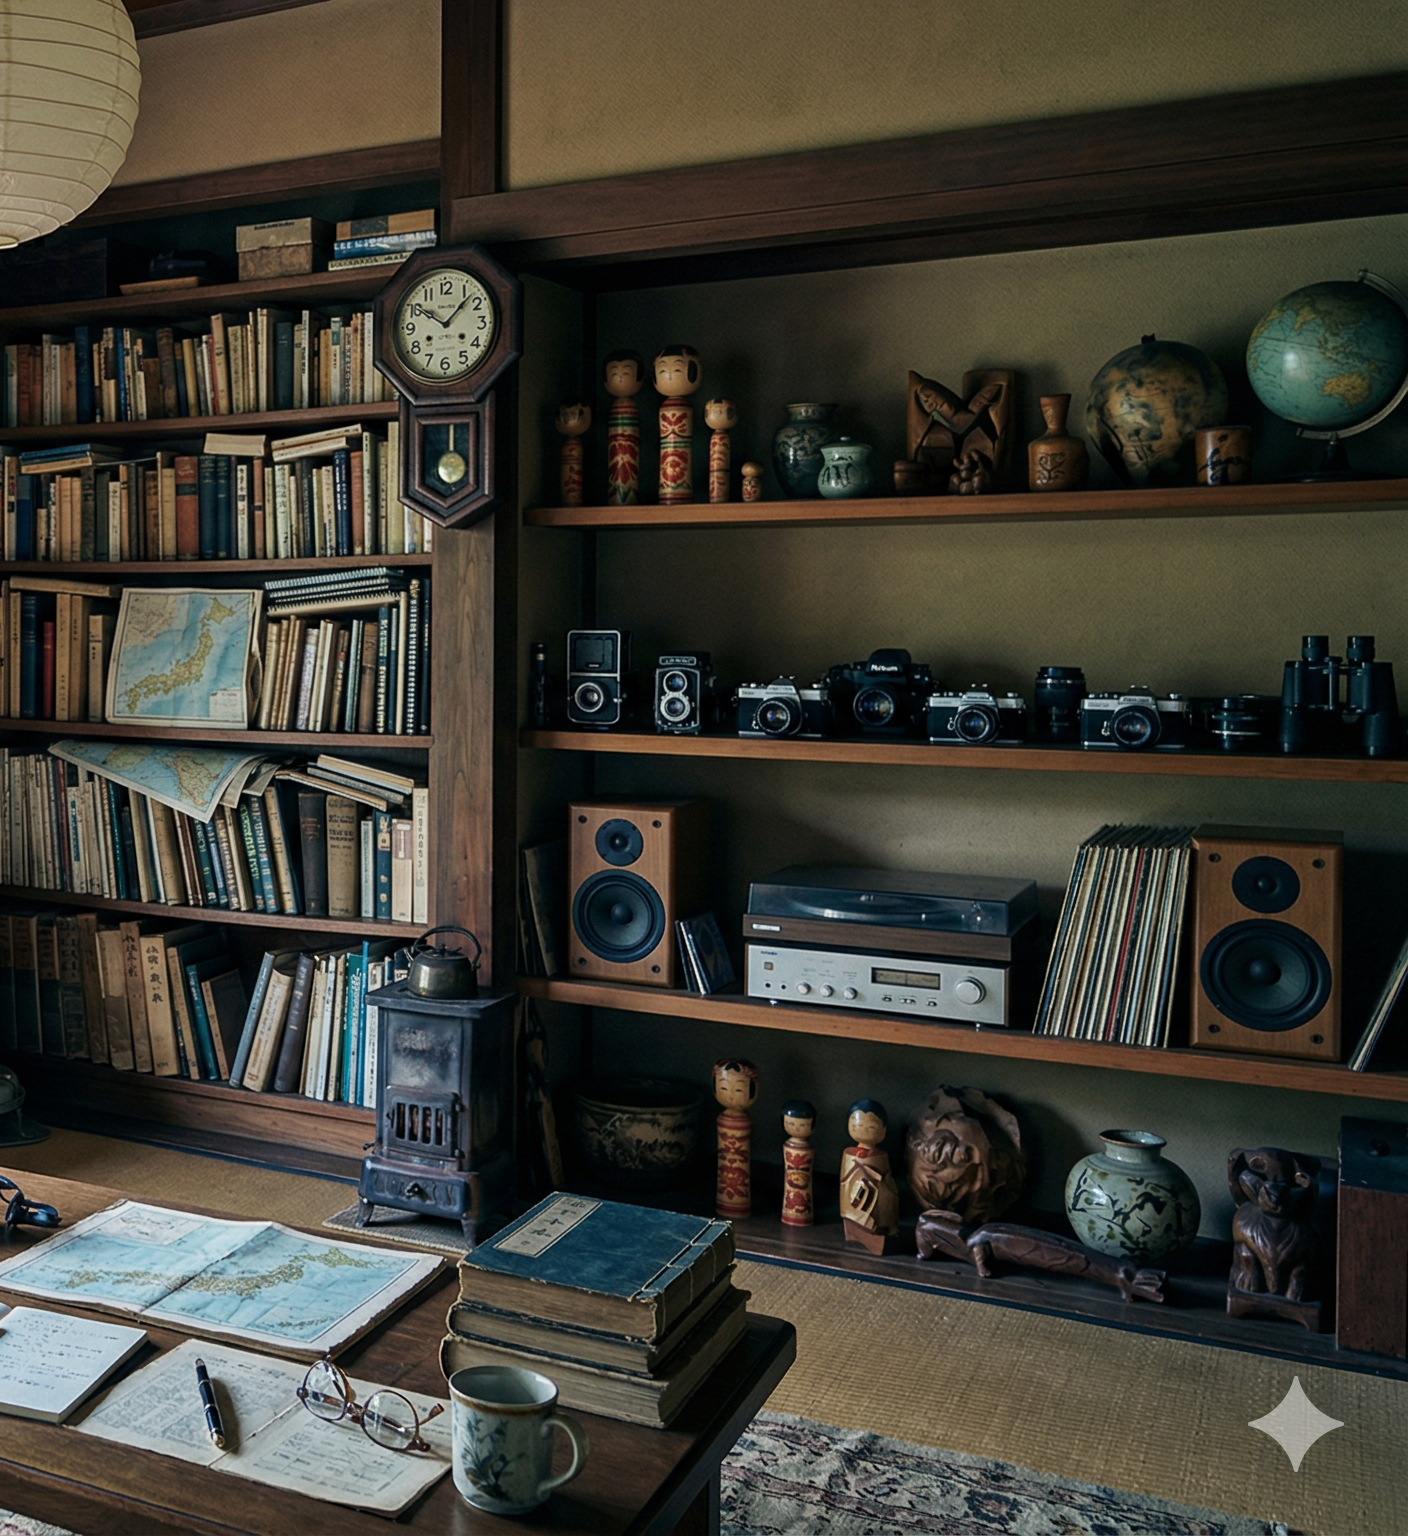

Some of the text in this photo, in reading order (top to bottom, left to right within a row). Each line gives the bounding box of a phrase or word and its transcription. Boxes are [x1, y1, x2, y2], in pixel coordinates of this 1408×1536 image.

[424, 287, 433, 302] 11
[440, 281, 453, 295] 12
[472, 297, 482, 311] 2
[406, 322, 416, 336] 9
[477, 316, 487, 330] 3
[411, 341, 421, 354] 8
[470, 336, 481, 349] 4
[425, 354, 434, 368] 7
[440, 357, 450, 370] 6
[459, 350, 468, 364] 5
